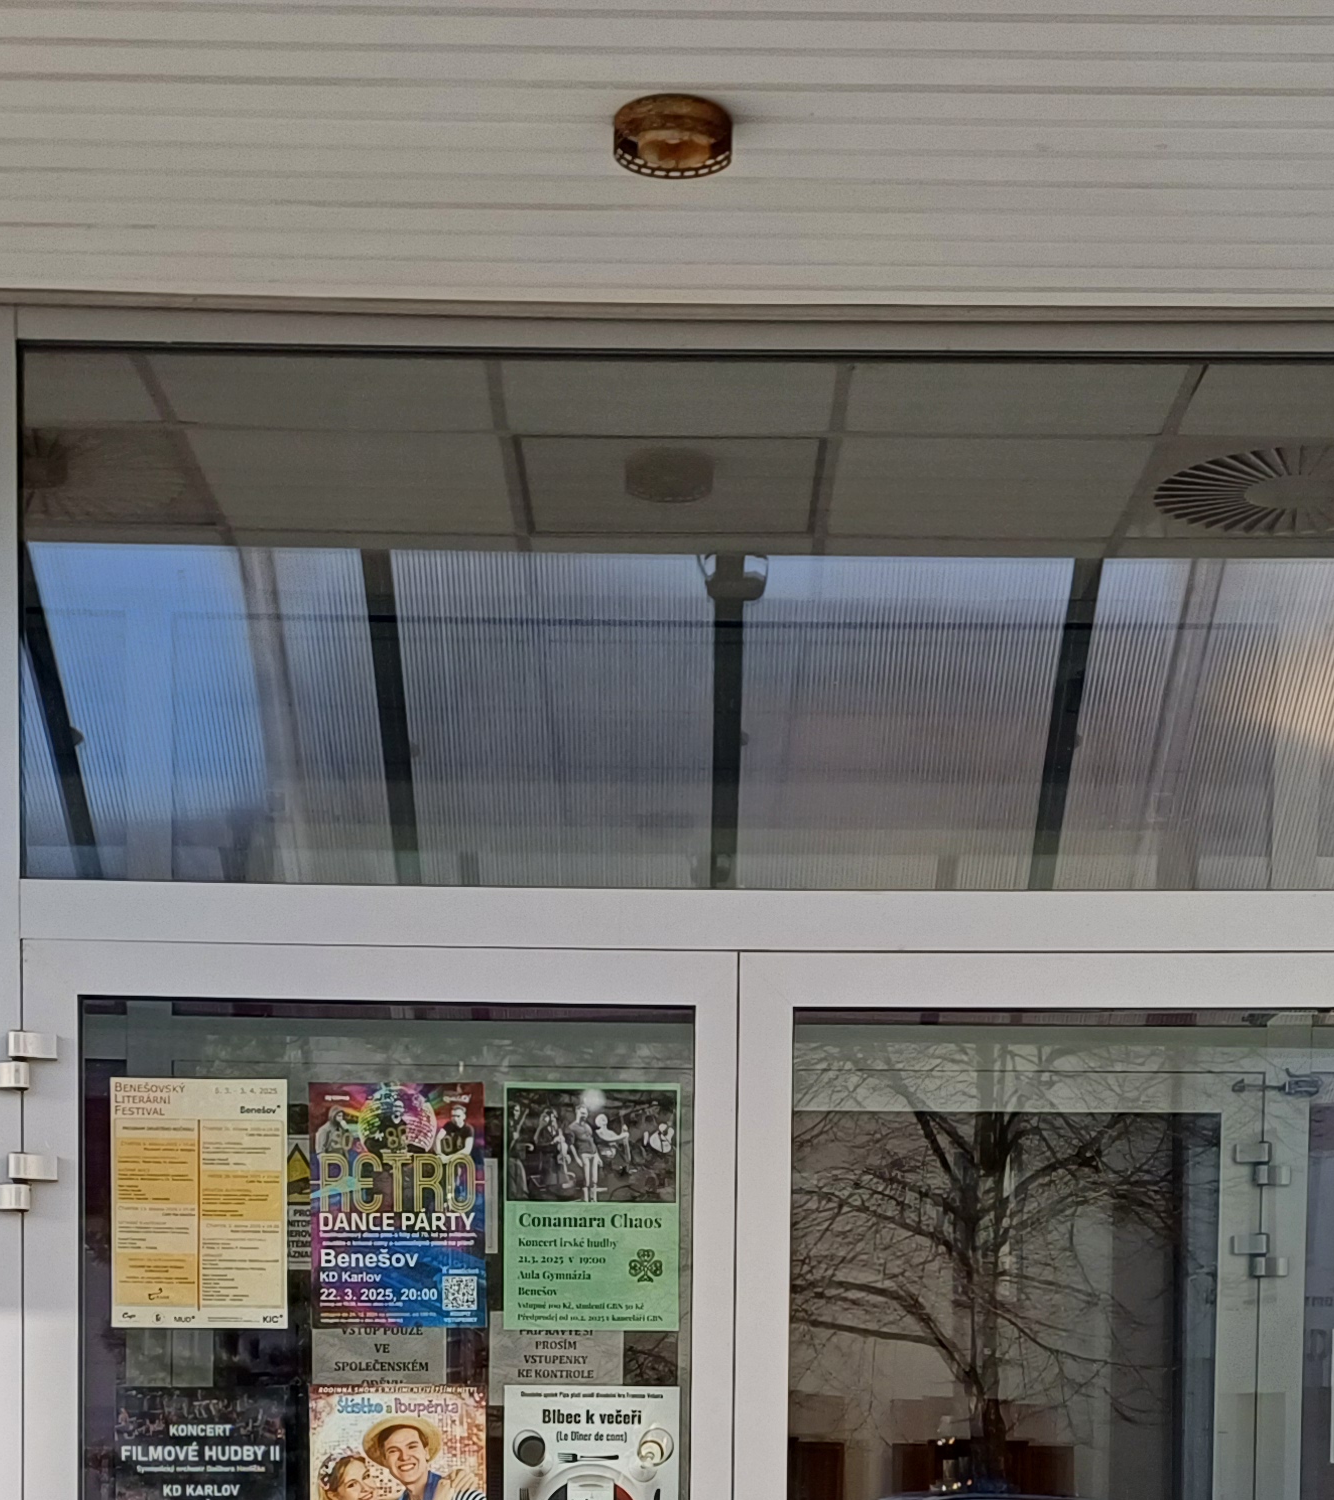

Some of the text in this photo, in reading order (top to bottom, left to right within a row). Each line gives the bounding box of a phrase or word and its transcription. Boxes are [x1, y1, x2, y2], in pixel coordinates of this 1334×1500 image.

[320, 1153, 476, 1212] RETRO
[320, 1209, 475, 1230] DANCE PÁRTY
[519, 1213, 662, 1228] Conamara Chaos
[518, 1238, 557, 1247] Koncert
[587, 1238, 618, 1249] hudby
[321, 1249, 418, 1267] Benešov
[541, 1256, 564, 1264] 2025
[320, 1272, 381, 1283] KD Karlov
[518, 1270, 591, 1281] Aula Gymnázia
[320, 1289, 437, 1302] 22. 3. 2025, 20:00
[518, 1287, 557, 1296] Benešov
[374, 1344, 389, 1353] VE
[535, 1340, 576, 1350] PROSÍM
[524, 1355, 588, 1364] VSTUPENKY
[335, 1360, 428, 1372] SPOLEČENSKÉM
[517, 1369, 594, 1379] KE KONTROLE
[386, 1405, 392, 1413] a
[542, 1409, 641, 1424] Blbec k večeři
[169, 1425, 231, 1436] KONCERT
[594, 1432, 603, 1441] de
[121, 1442, 280, 1461] FILMOVÉ HUDBY II
[163, 1485, 240, 1496] KD KARLOV
